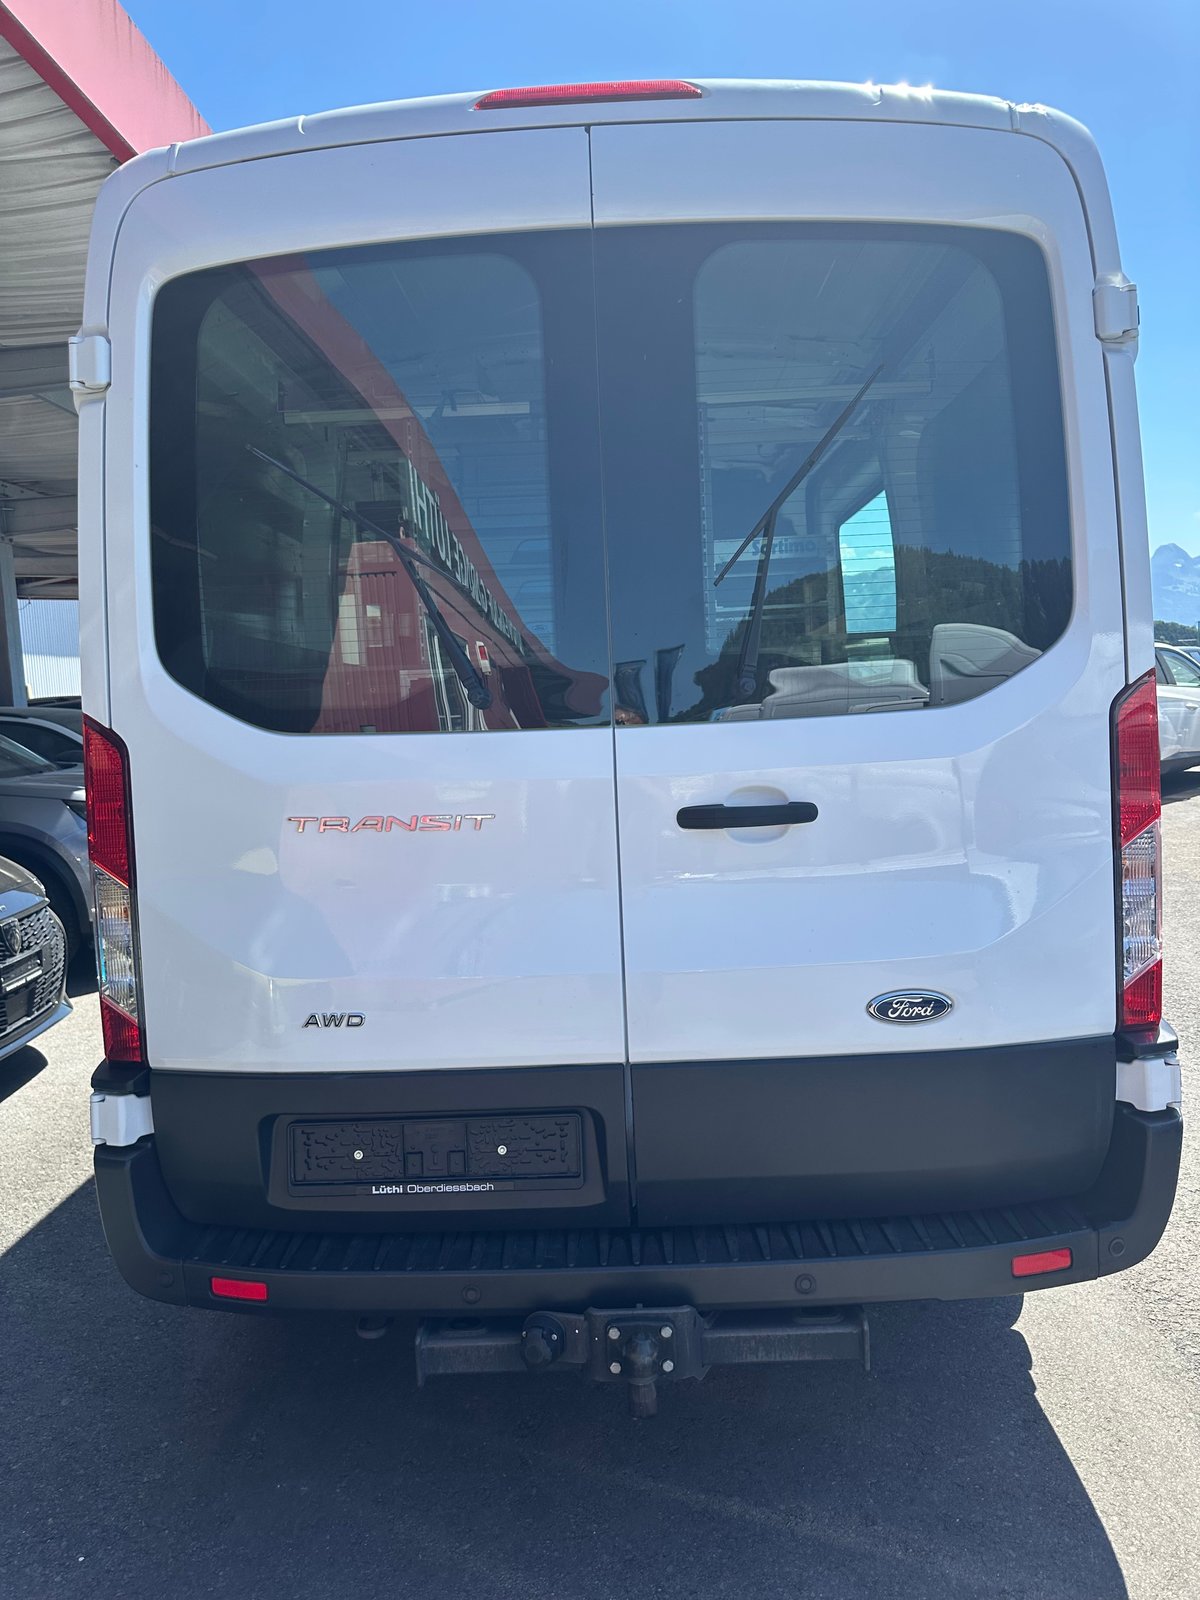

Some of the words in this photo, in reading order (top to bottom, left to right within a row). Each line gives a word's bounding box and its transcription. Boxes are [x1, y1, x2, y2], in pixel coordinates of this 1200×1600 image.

[751, 537, 817, 556] Sortimo
[287, 813, 496, 834] TRANSIT
[887, 997, 935, 1018] Ford
[302, 1012, 366, 1028] AWD
[372, 1185, 403, 1194] Lüthi
[407, 1182, 495, 1193] Oberdiessbach
